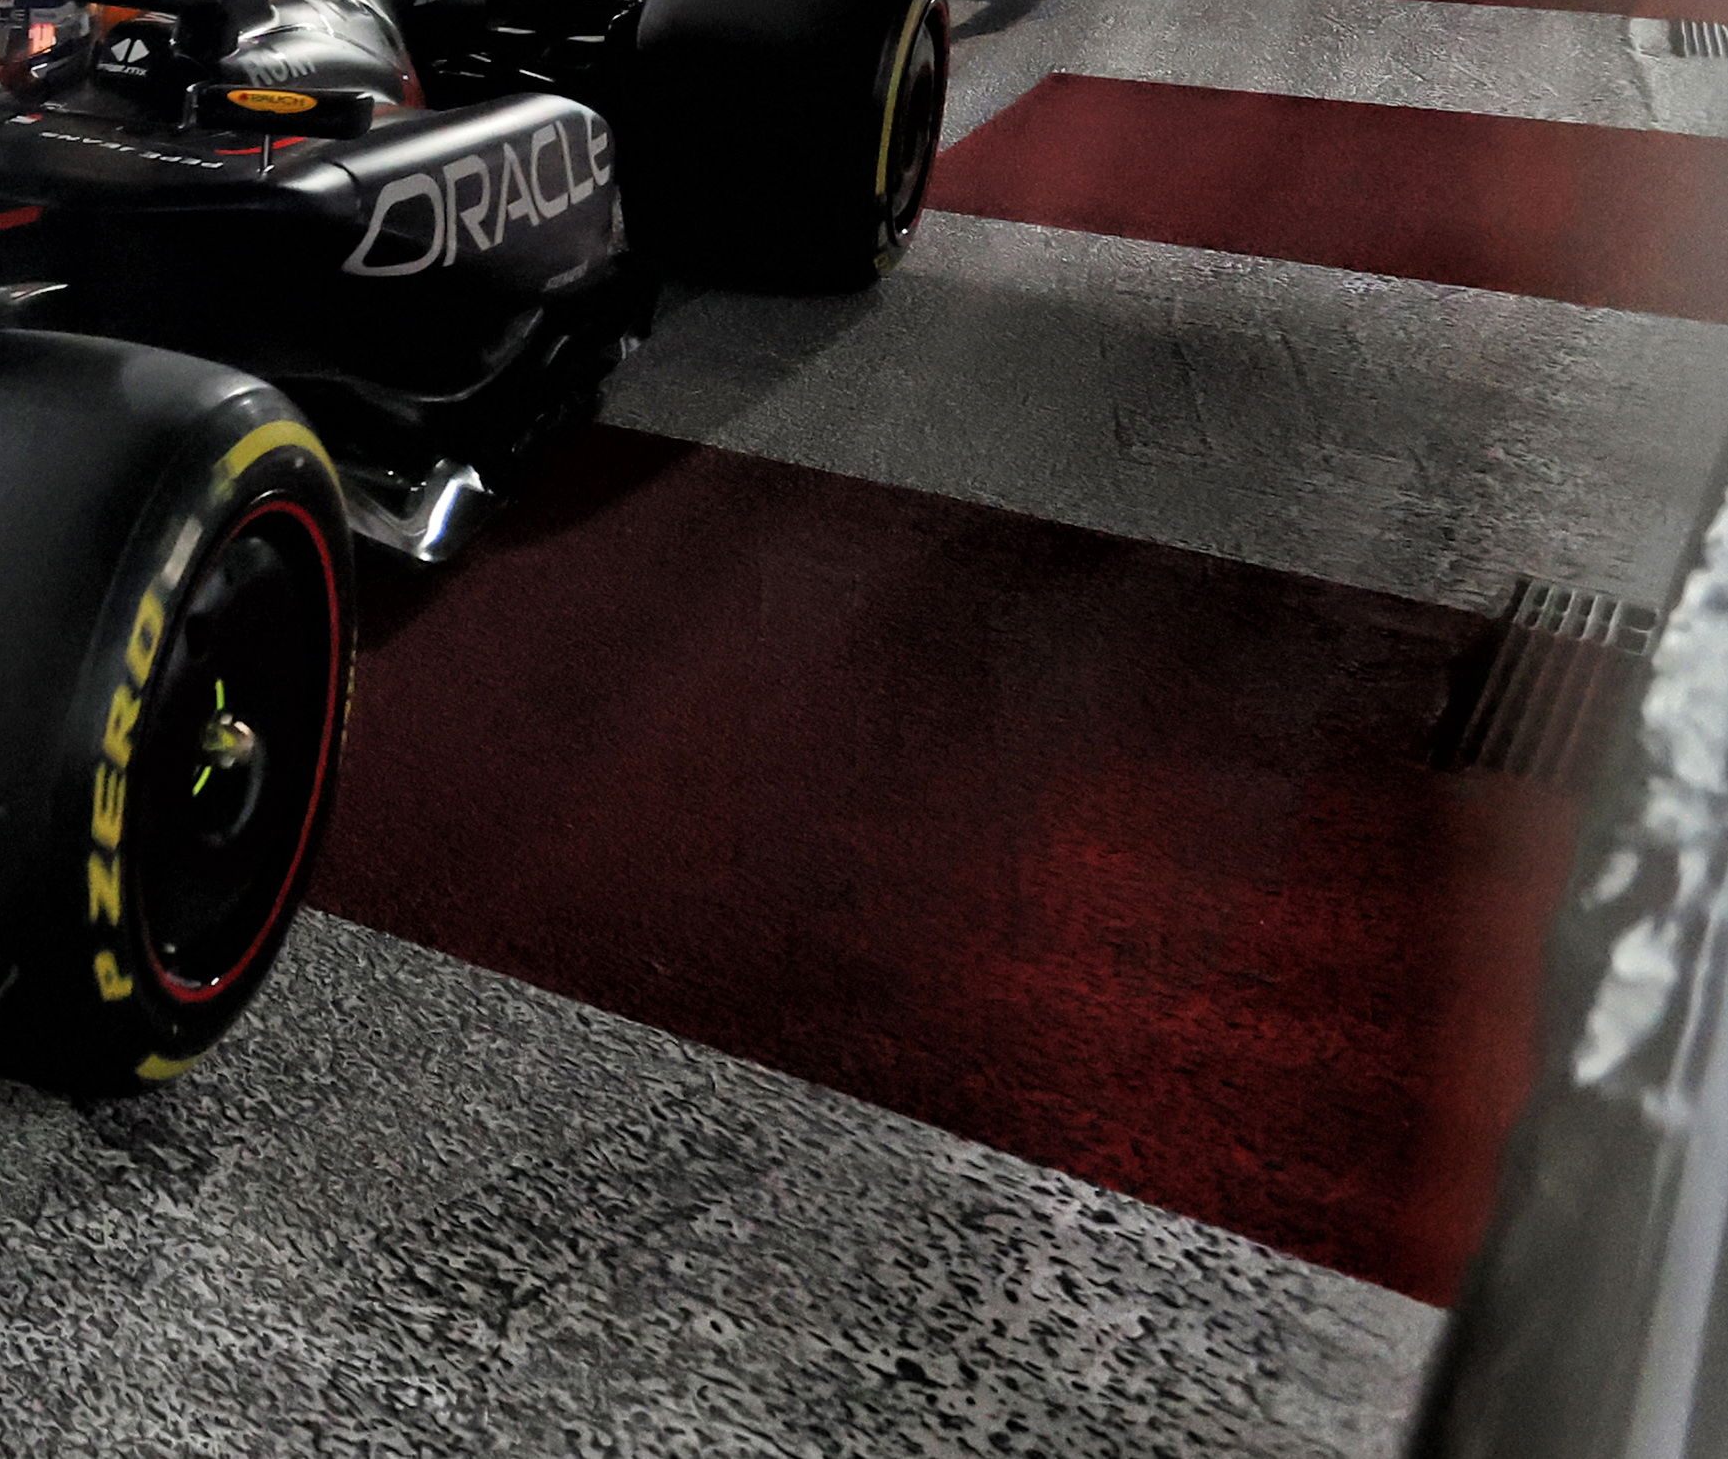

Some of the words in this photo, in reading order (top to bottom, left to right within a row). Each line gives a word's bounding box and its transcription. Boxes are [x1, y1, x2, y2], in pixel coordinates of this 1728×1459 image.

[342, 112, 612, 277] ORACLE
[88, 590, 165, 927] ZERO
[93, 950, 134, 1002] P
